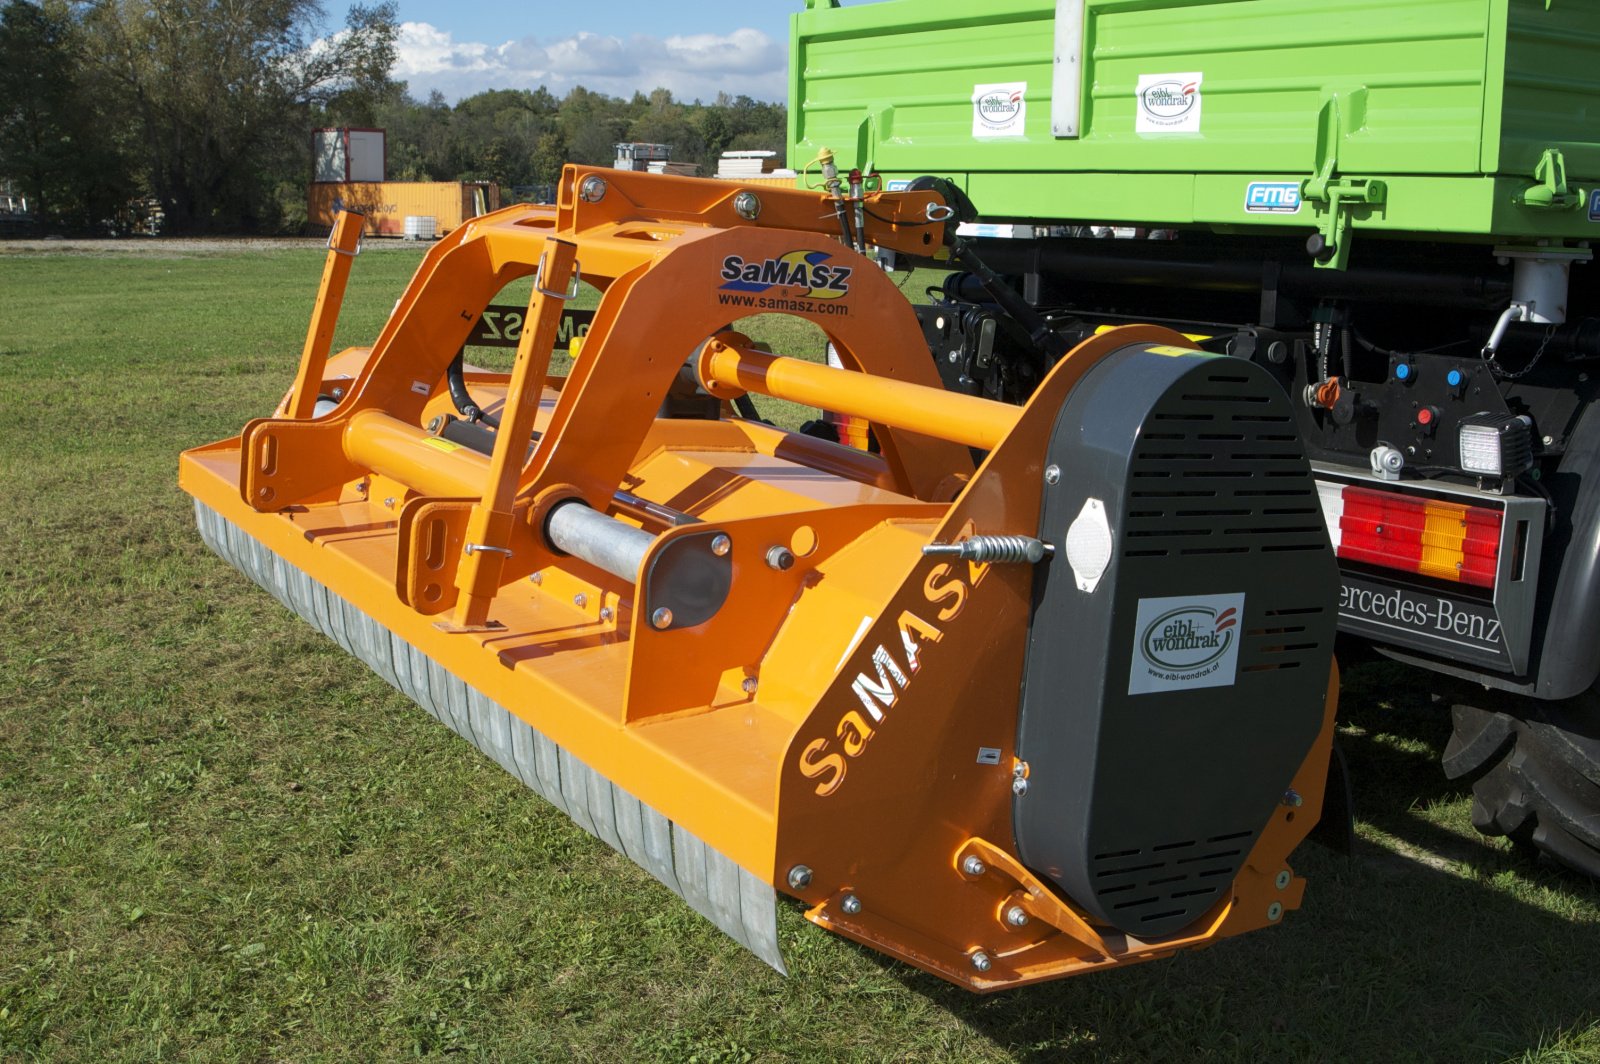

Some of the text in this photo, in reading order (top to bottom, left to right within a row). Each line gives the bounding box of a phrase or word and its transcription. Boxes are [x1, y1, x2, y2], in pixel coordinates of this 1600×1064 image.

[982, 101, 1015, 113] wondrak
[1148, 93, 1188, 106] wondrak
[1250, 187, 1299, 203] FMG
[721, 254, 853, 291] SaMASZ
[718, 293, 848, 316] www.samasz.com
[1338, 584, 1501, 644] ercedes-Benz
[1152, 630, 1220, 652] wondrak
[1147, 661, 1220, 681] www.eibl-wondrak.at
